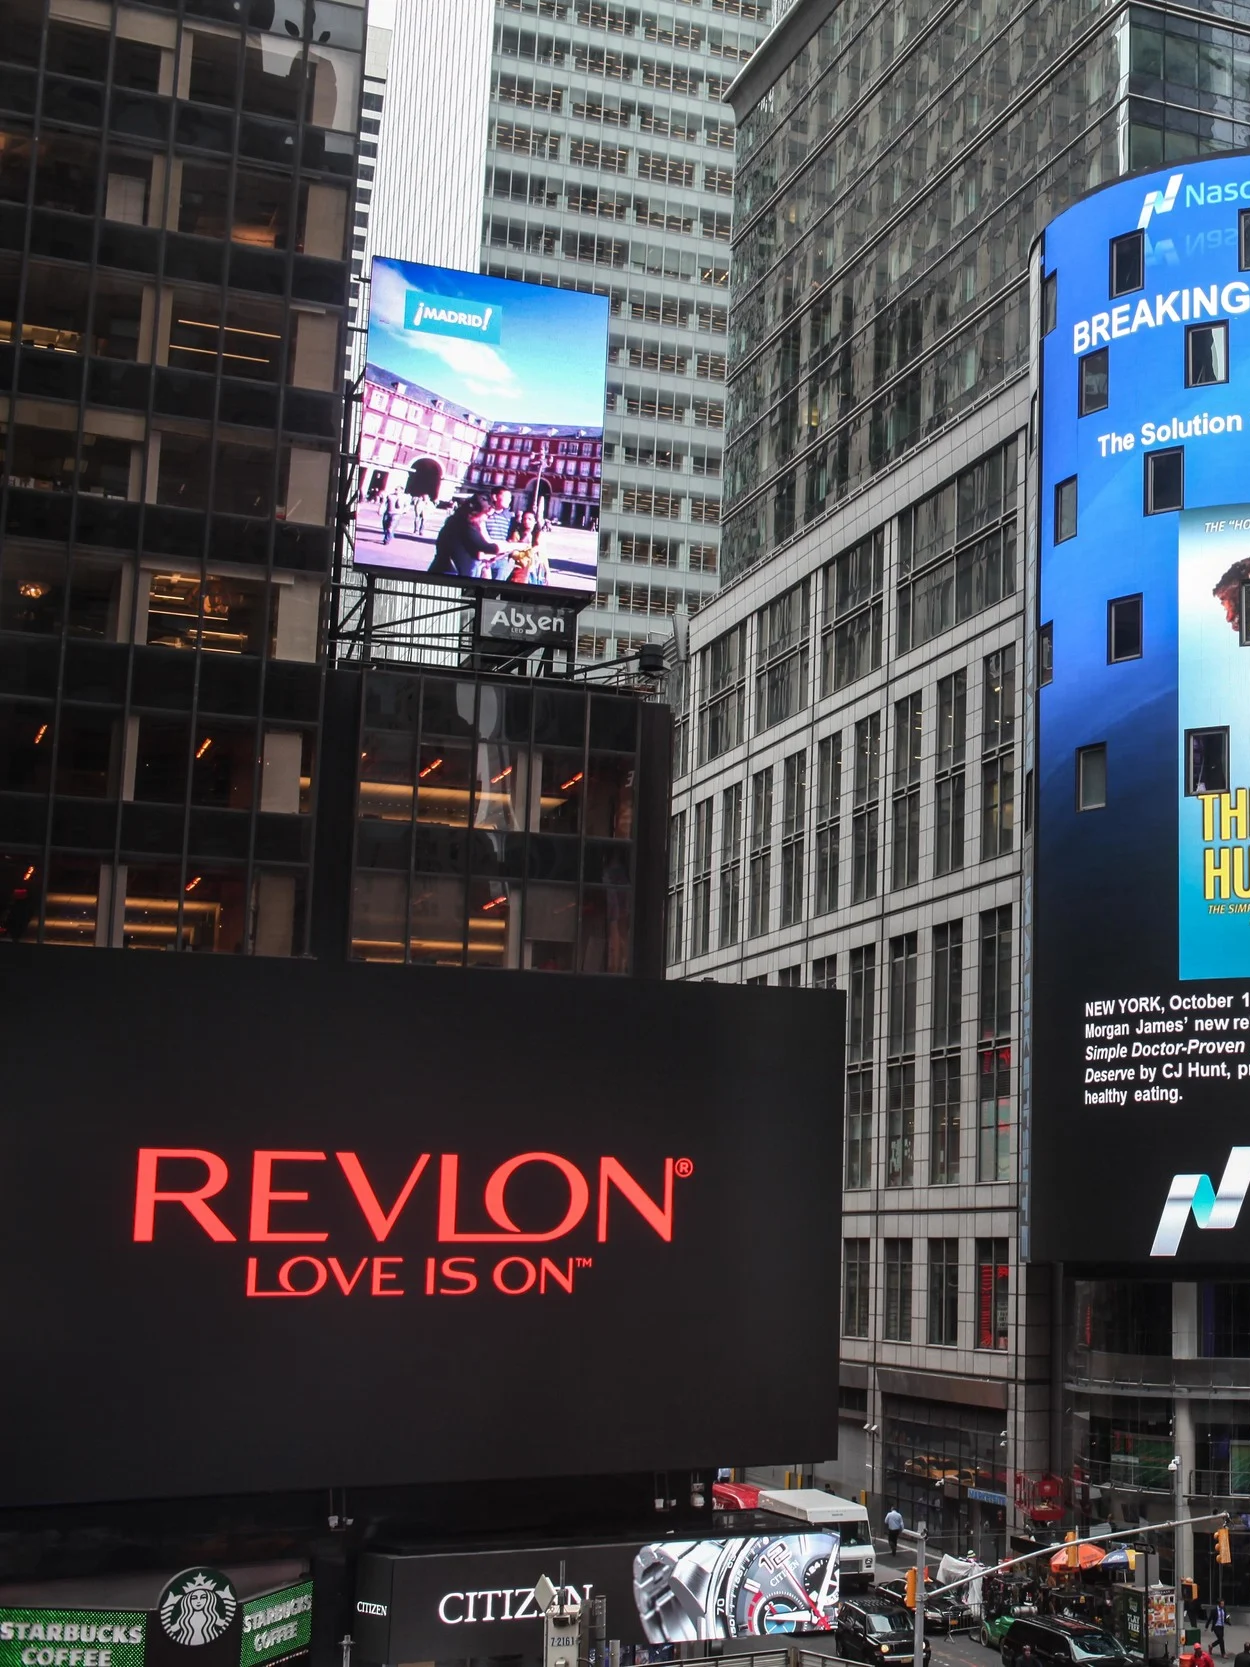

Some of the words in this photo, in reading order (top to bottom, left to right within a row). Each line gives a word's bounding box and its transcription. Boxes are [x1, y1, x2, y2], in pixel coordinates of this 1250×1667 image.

[1073, 281, 1250, 355] BREAKING
[1097, 431, 1135, 457] The
[1140, 411, 1243, 446] Solution
[1204, 521, 1225, 533] THE
[1208, 904, 1225, 914] THE
[1085, 1000, 1115, 1017] NEW
[1119, 996, 1165, 1014] YORK,
[1169, 993, 1234, 1010] October
[1085, 1023, 1129, 1039] Morgan
[1194, 1018, 1229, 1031] new
[1085, 1043, 1127, 1062] Simple
[1131, 1039, 1245, 1057] Doctor-Proven
[1084, 1068, 1135, 1083] Deserve
[1140, 1065, 1156, 1082] by
[1162, 1063, 1183, 1078] CJ
[1188, 1061, 1231, 1079] Hunt,
[1084, 1087, 1127, 1105] healthy
[1134, 1086, 1183, 1103] eating.
[246, 1256, 404, 1297] LOVE
[425, 1257, 478, 1295] IS
[243, 1594, 312, 1633] STARBUCKS
[357, 1601, 388, 1616] CITIZEN
[0, 1621, 143, 1644] STARBUCKS
[253, 1620, 298, 1651] COFFEE
[22, 1647, 113, 1667] COFFEE
